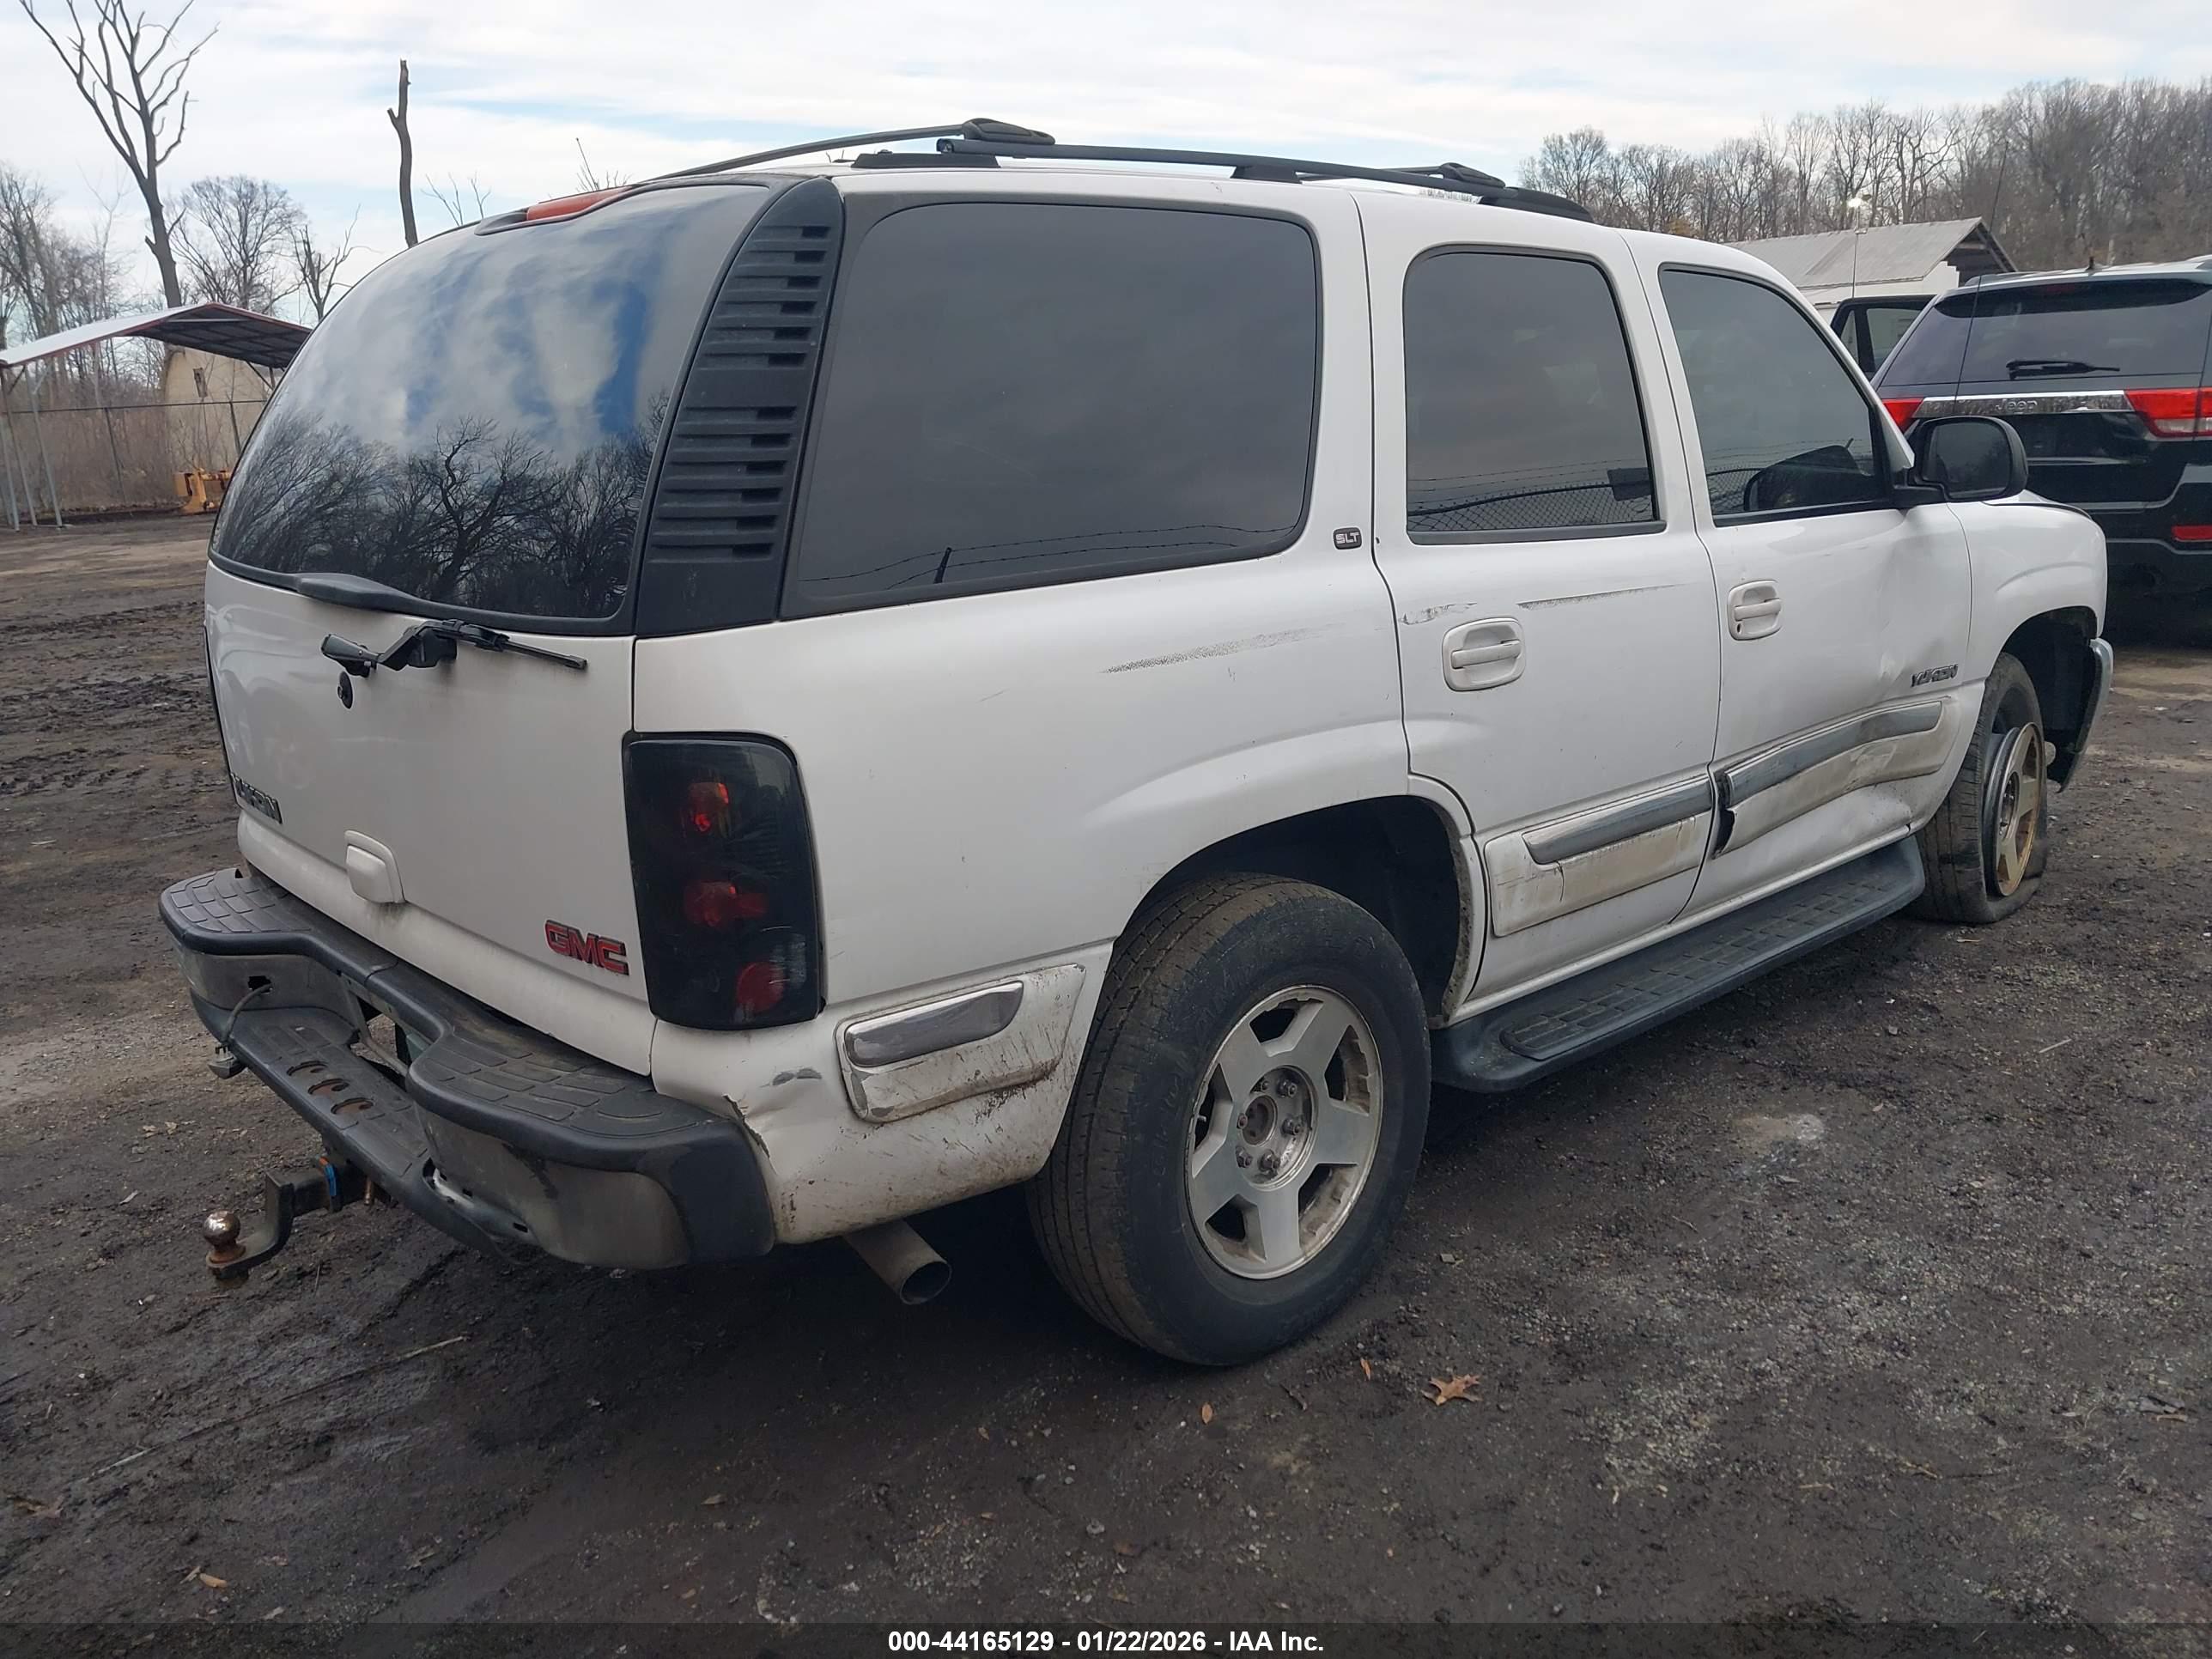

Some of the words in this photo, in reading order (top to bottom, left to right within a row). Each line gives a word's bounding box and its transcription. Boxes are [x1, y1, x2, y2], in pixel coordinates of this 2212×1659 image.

[1995, 398, 2039, 410] Jeep
[1335, 531, 1360, 544] SLT
[544, 920, 629, 975] GMC
